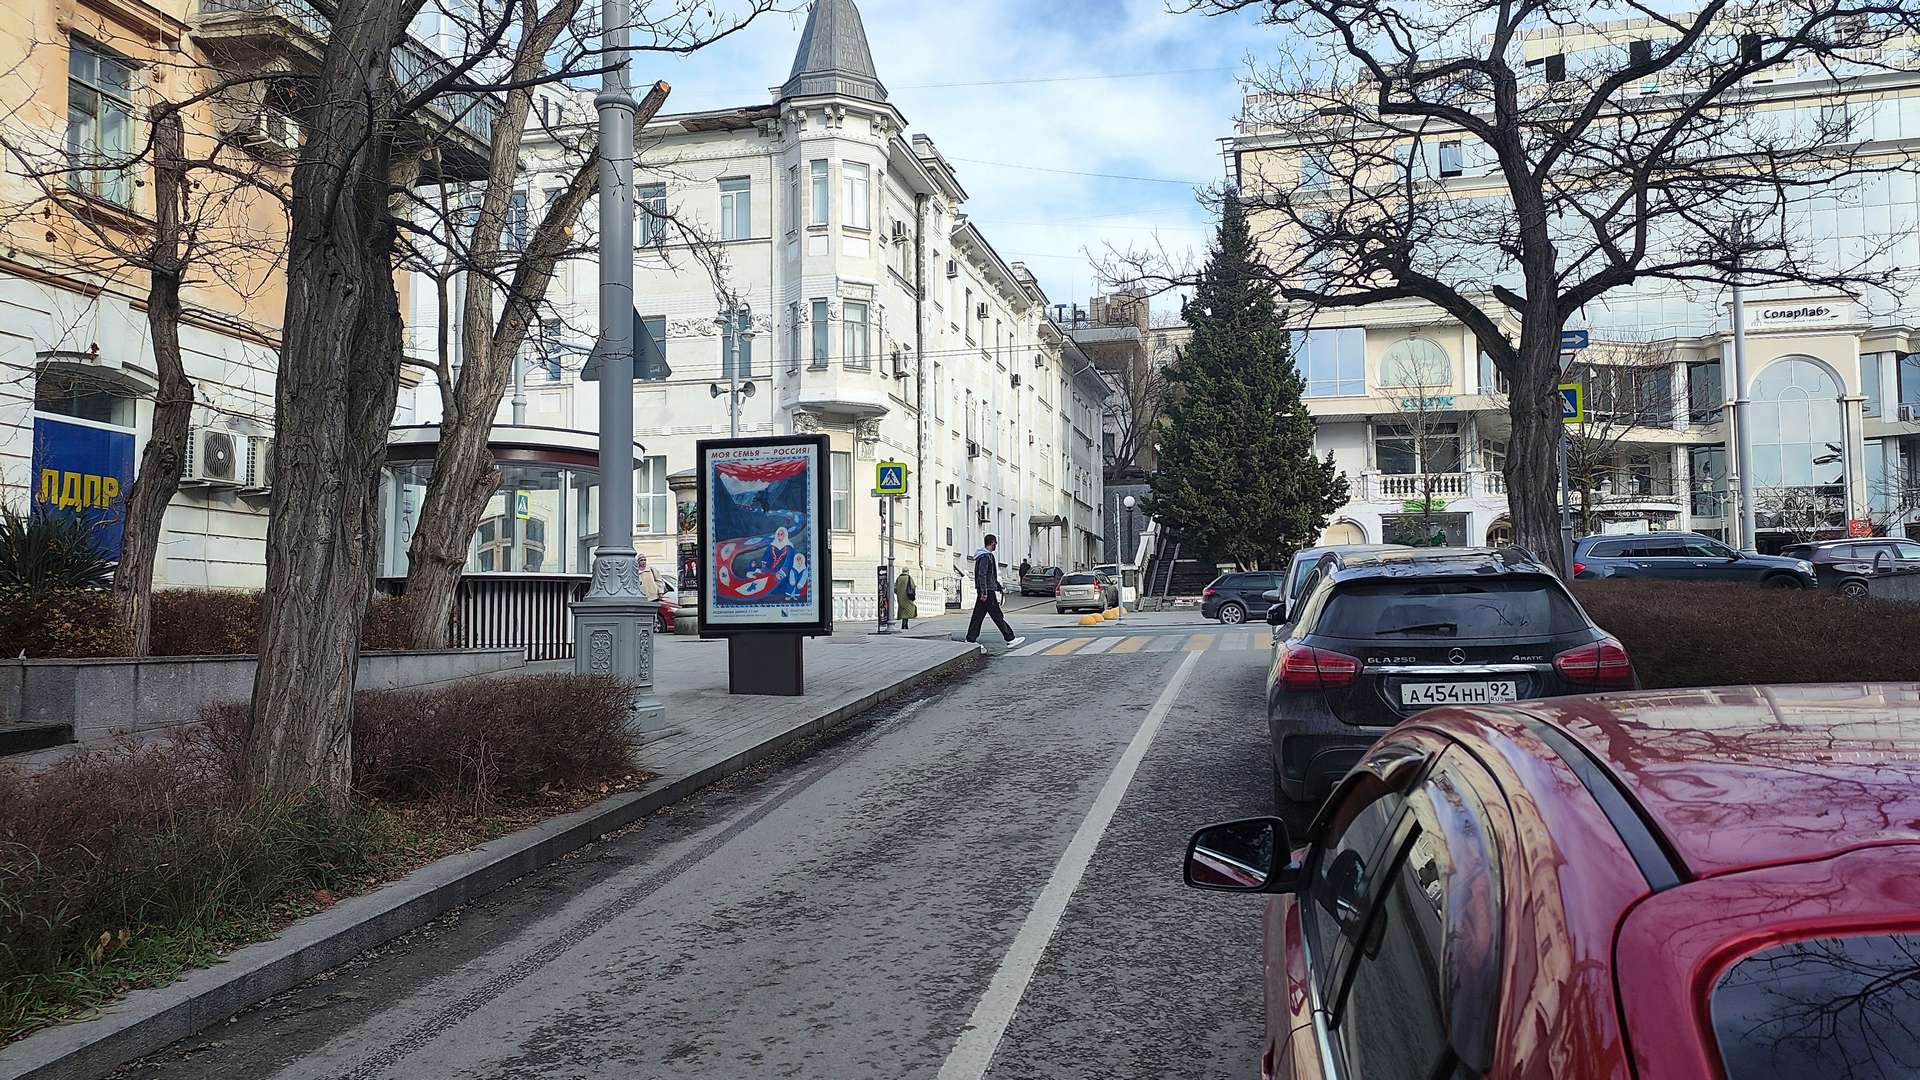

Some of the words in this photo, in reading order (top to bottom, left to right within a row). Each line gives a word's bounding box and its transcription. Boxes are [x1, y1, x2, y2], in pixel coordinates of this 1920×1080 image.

[711, 451, 730, 459] МОЯ
[732, 449, 760, 458] СЕМЬЯ
[773, 447, 810, 456] РОССИЯ!
[40, 468, 119, 512] ЛДПР
[1490, 682, 1510, 696] 92
